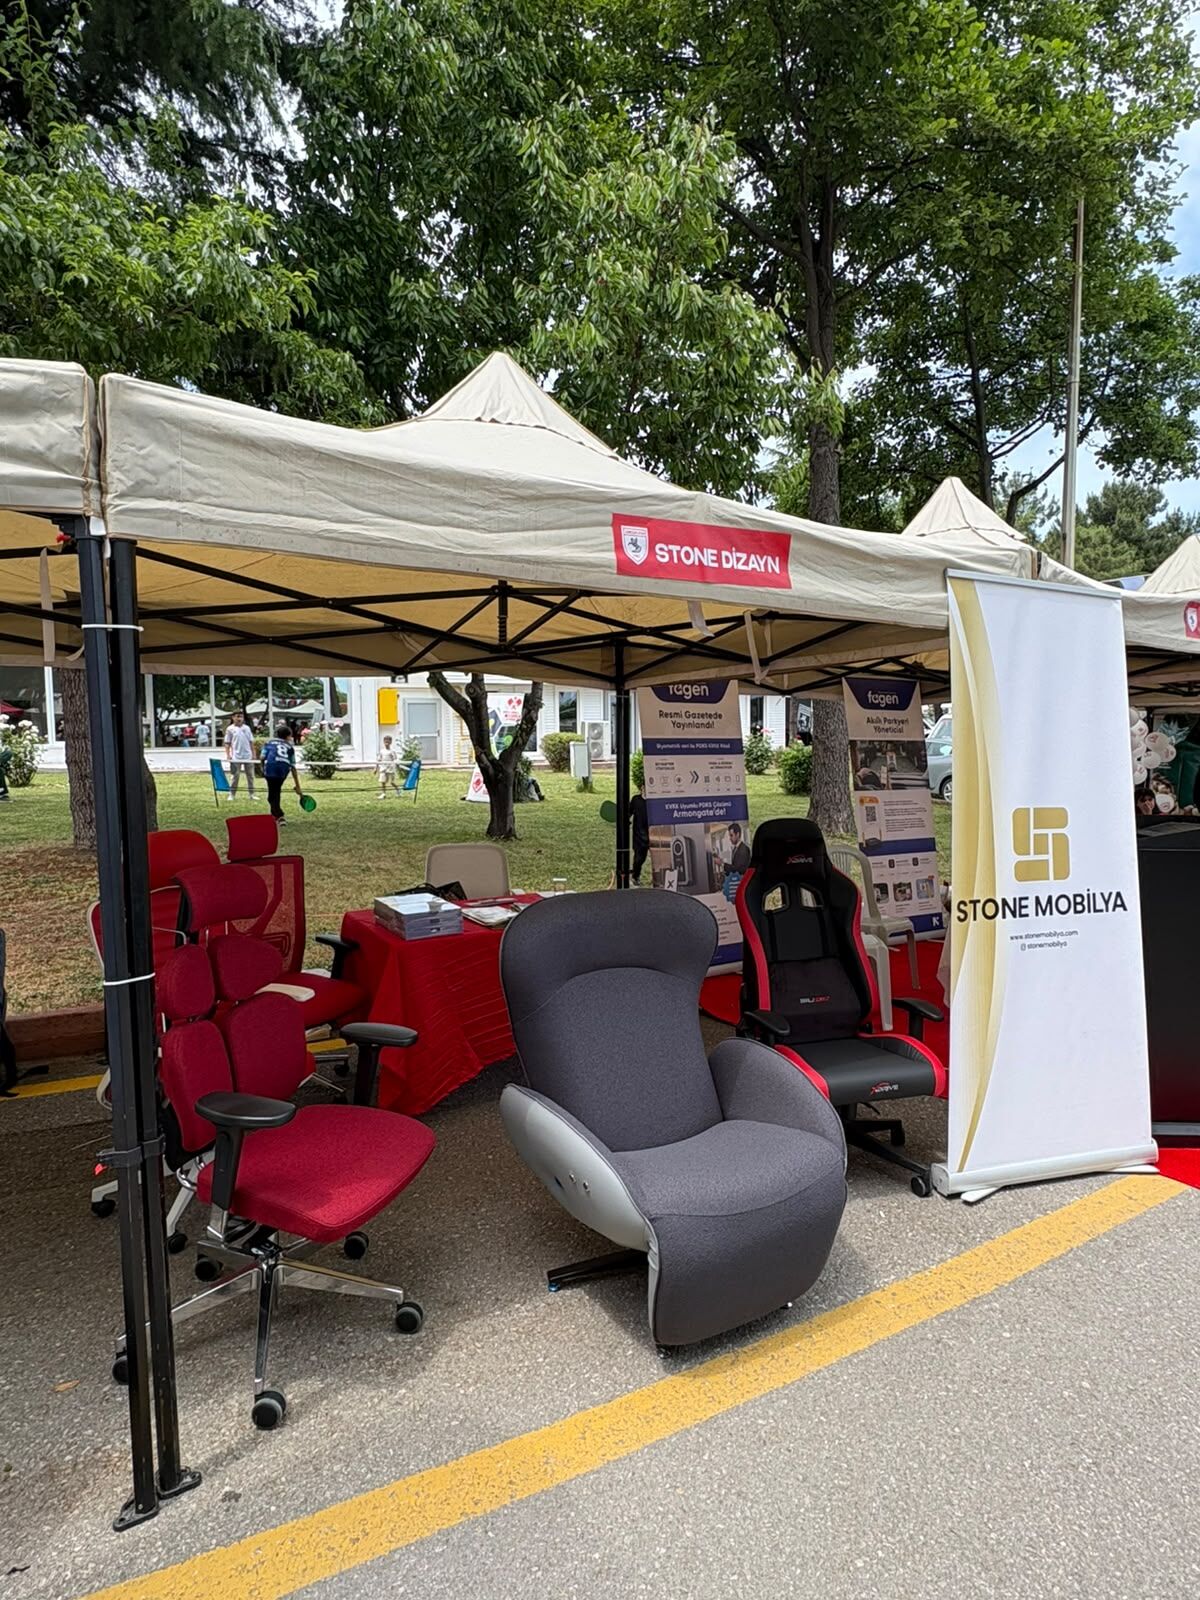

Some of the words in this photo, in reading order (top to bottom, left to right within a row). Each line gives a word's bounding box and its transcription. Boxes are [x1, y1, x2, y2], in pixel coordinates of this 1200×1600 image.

[655, 543, 718, 568] STONE
[721, 547, 781, 574] DİZAYN
[658, 709, 683, 720] Resmi
[684, 710, 723, 720] Gazetede
[276, 744, 289, 758] 8
[956, 896, 1030, 923] STONE
[1034, 888, 1128, 917] MOBİLYA
[1010, 930, 1079, 940] www.stonemobilya.com
[1027, 941, 1068, 949] stonemobilya
